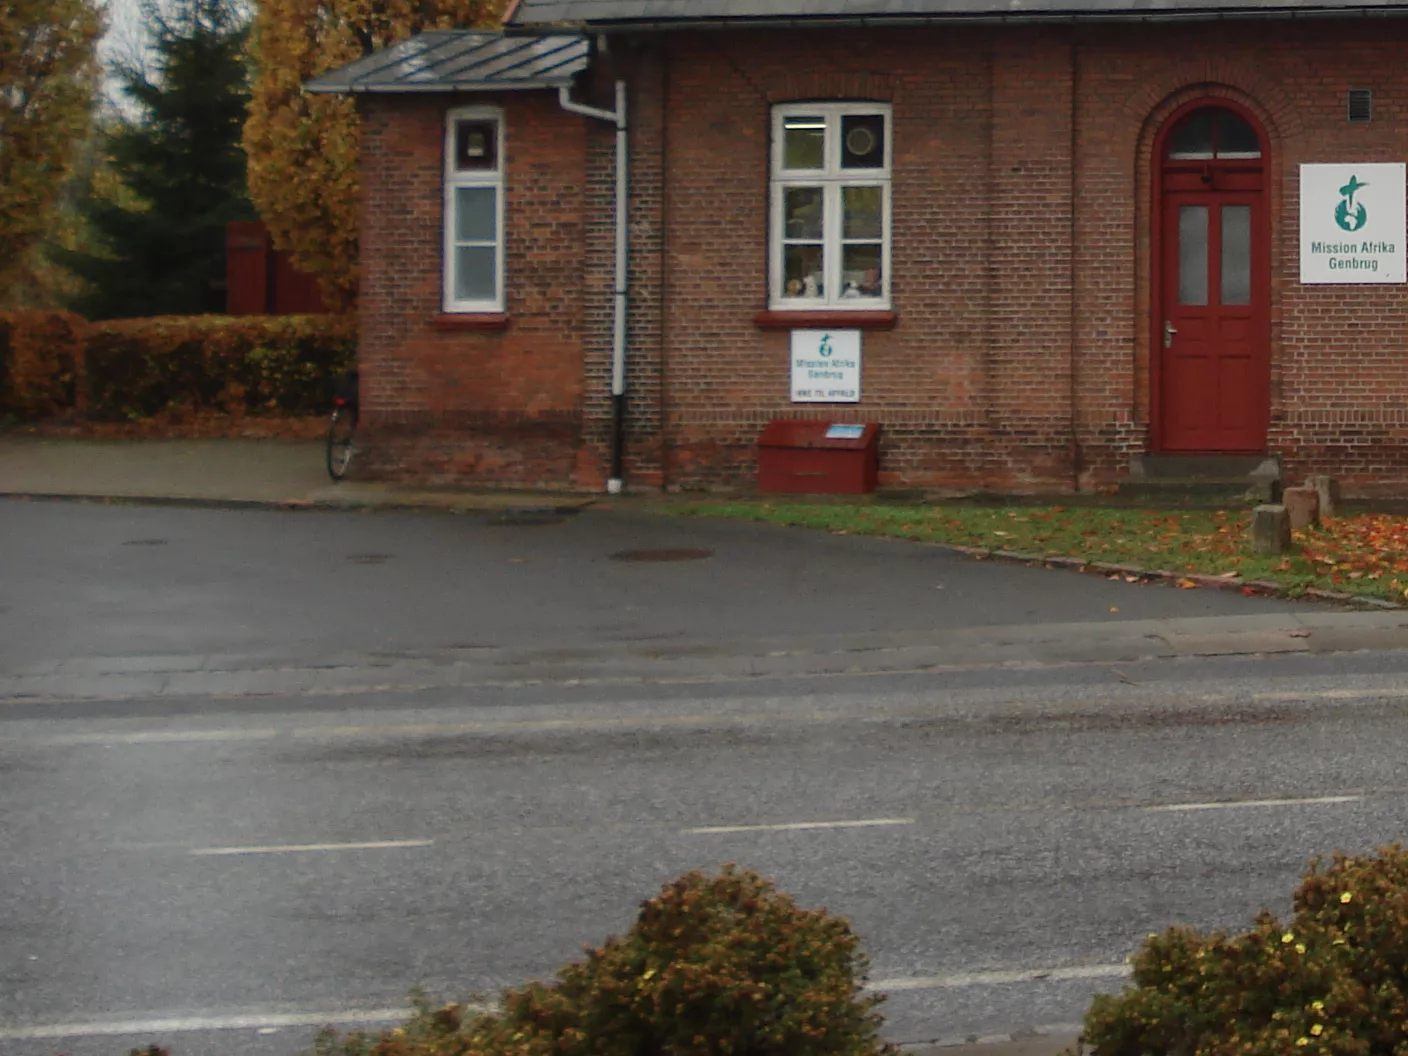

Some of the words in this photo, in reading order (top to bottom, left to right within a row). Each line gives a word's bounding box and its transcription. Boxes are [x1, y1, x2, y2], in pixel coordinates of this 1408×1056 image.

[1311, 242, 1357, 254] Mission
[1361, 242, 1395, 254] Afrika
[1328, 257, 1378, 272] Genbrug
